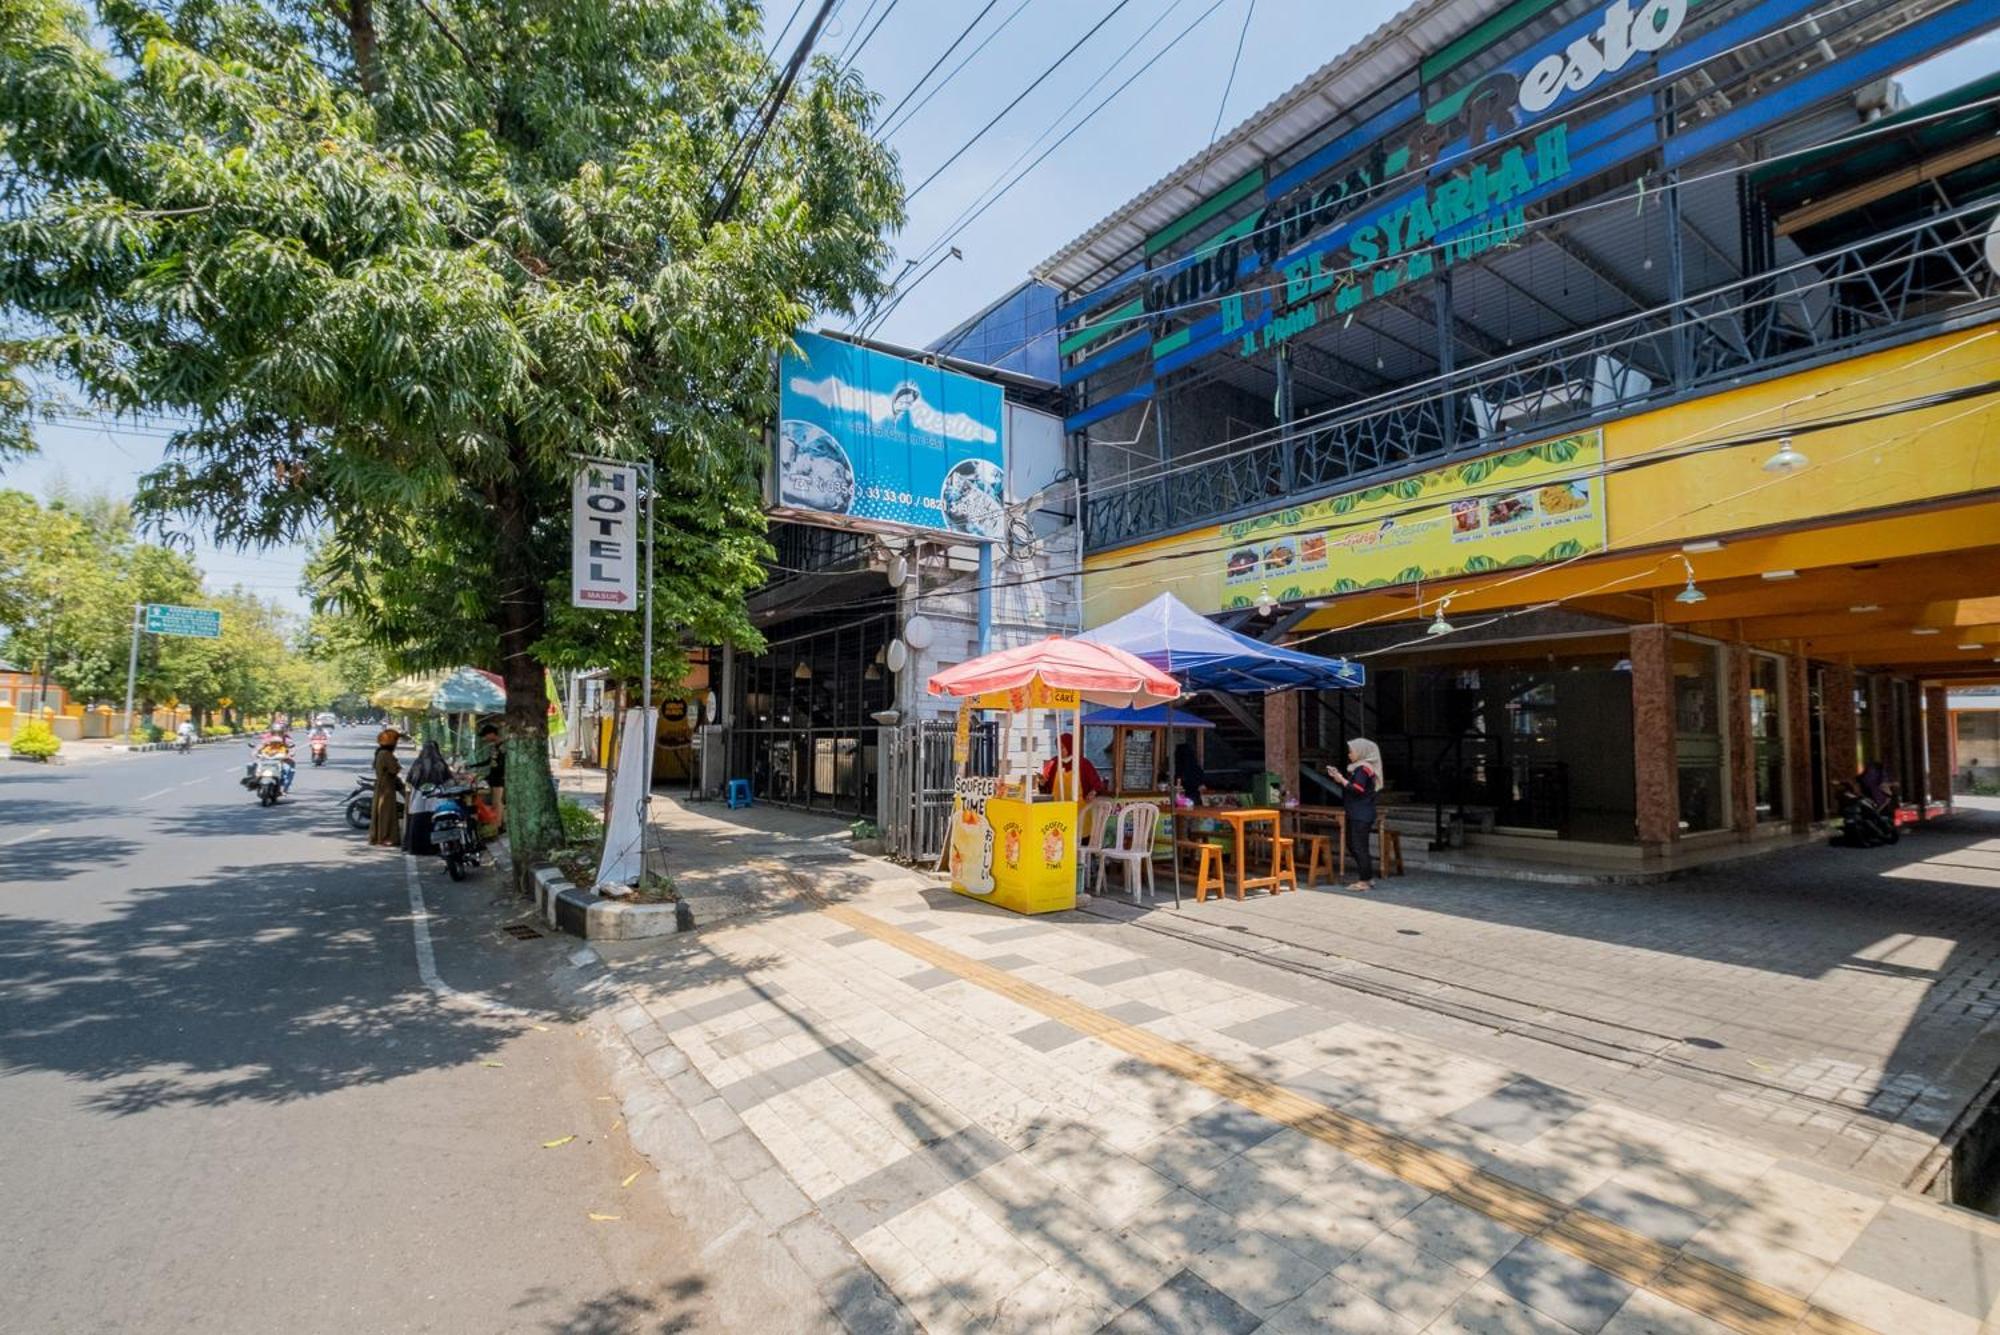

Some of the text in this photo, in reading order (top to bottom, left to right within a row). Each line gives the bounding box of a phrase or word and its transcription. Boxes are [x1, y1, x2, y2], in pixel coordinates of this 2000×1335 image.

[586, 472, 627, 584] HOTEL
[955, 776, 993, 798] SOUFFLE
[961, 797, 985, 816] TIME
